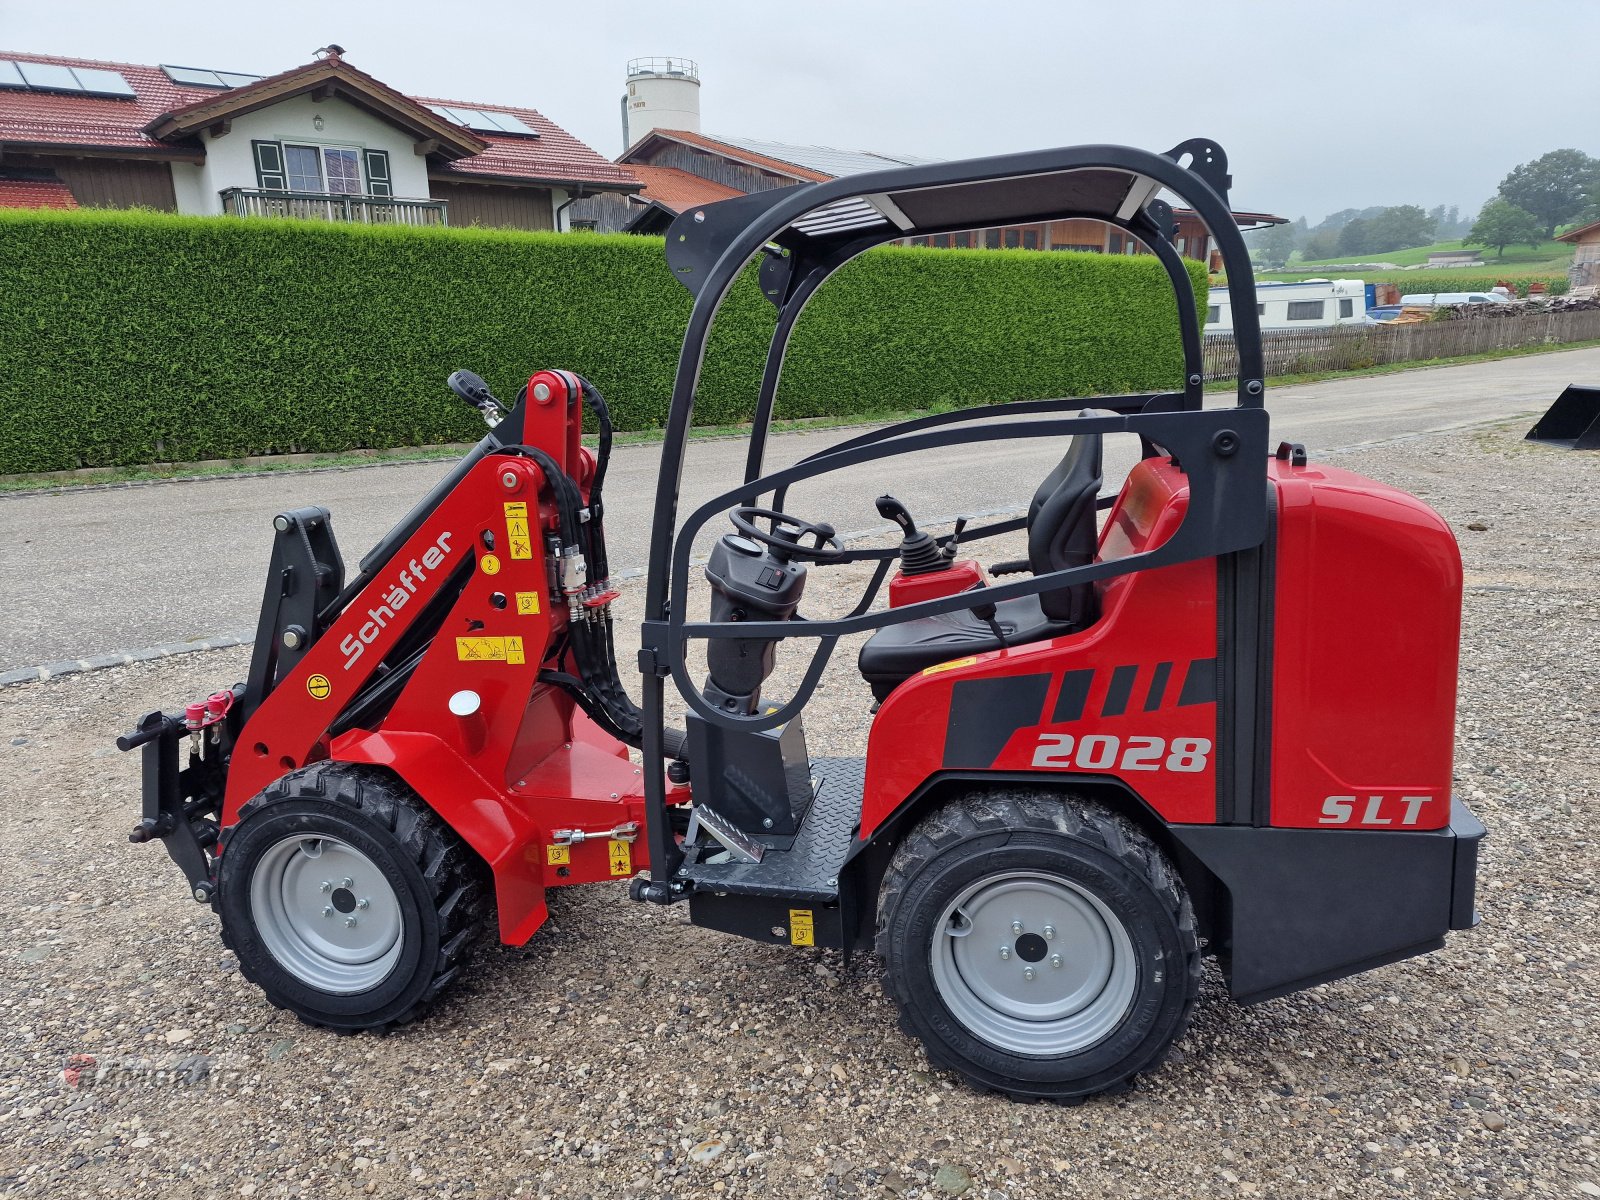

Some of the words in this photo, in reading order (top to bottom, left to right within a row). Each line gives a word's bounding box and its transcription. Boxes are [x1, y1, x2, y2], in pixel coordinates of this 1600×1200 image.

[340, 531, 452, 671] Schäffer
[1031, 733, 1212, 772] 2028
[1318, 795, 1433, 825] SLT
